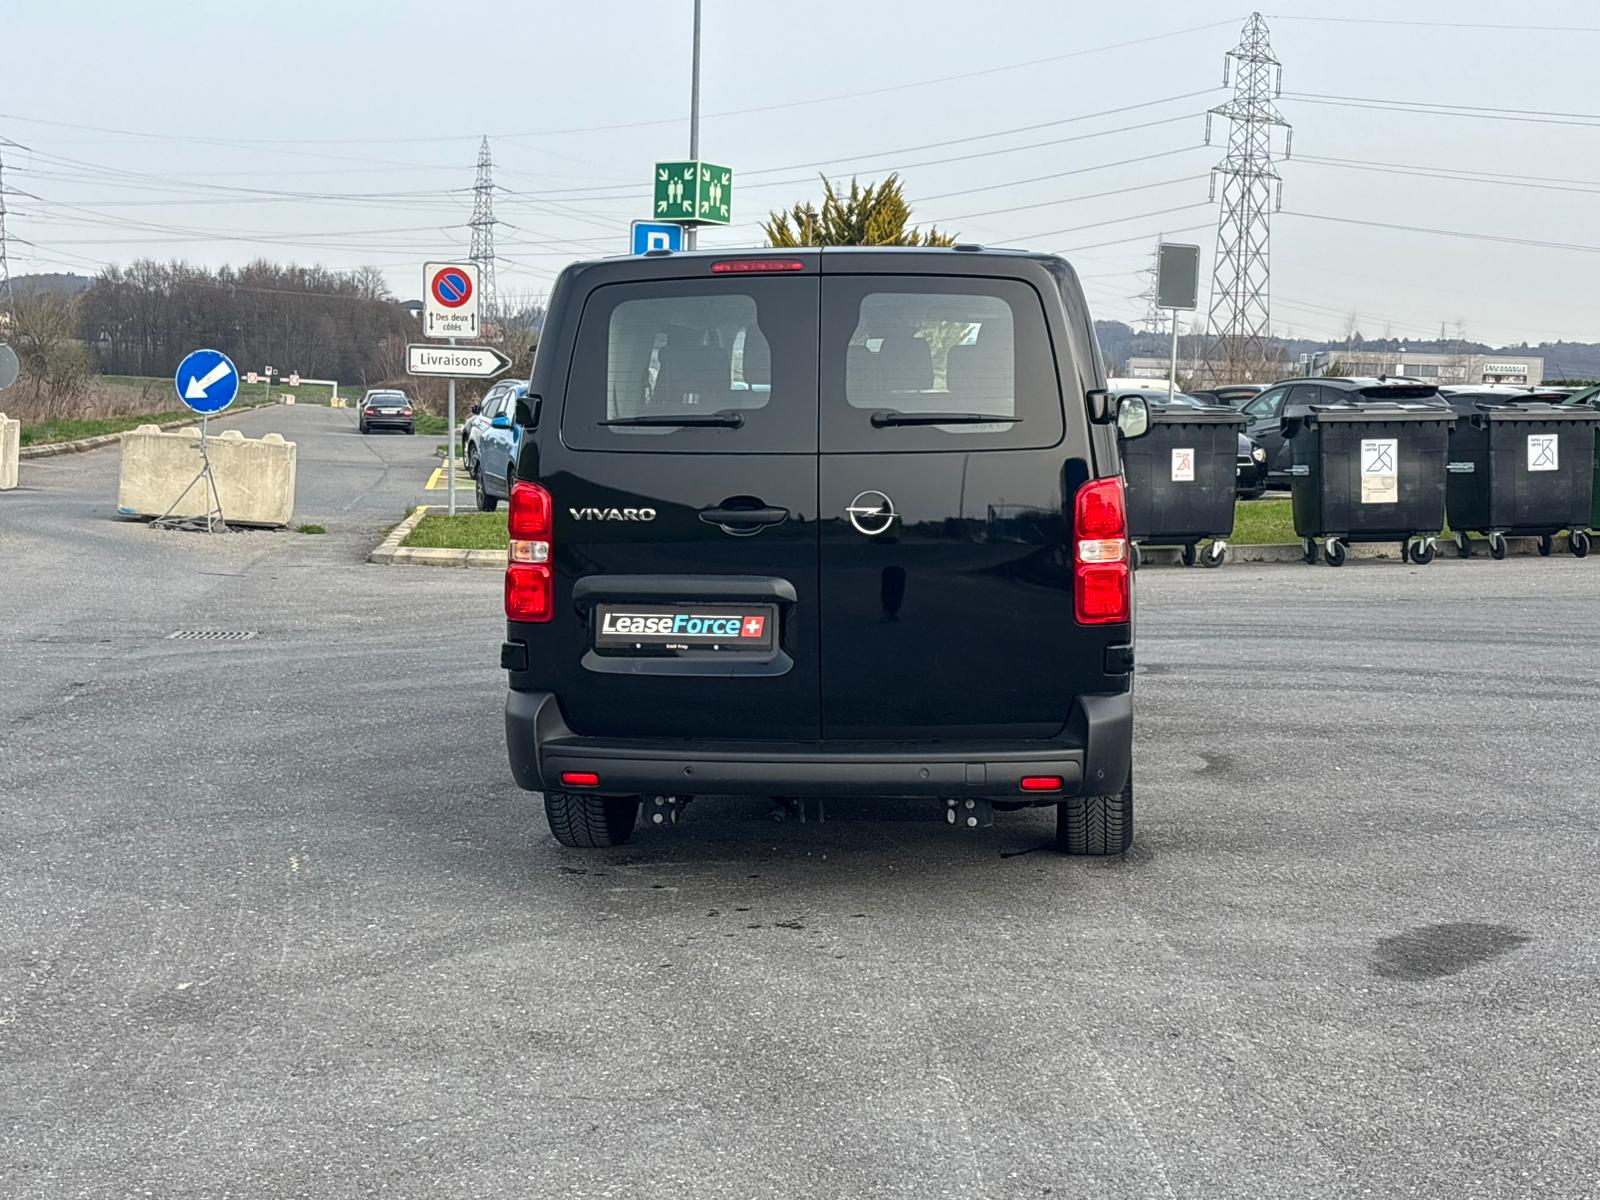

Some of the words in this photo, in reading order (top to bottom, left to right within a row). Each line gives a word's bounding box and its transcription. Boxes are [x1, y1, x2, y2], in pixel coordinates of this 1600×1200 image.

[435, 312, 449, 321] Des
[451, 313, 469, 322] deux
[442, 324, 462, 332] côtés
[420, 353, 483, 367] Livraisons
[569, 508, 657, 521] VIVARO
[602, 613, 741, 634] LeaseForce
